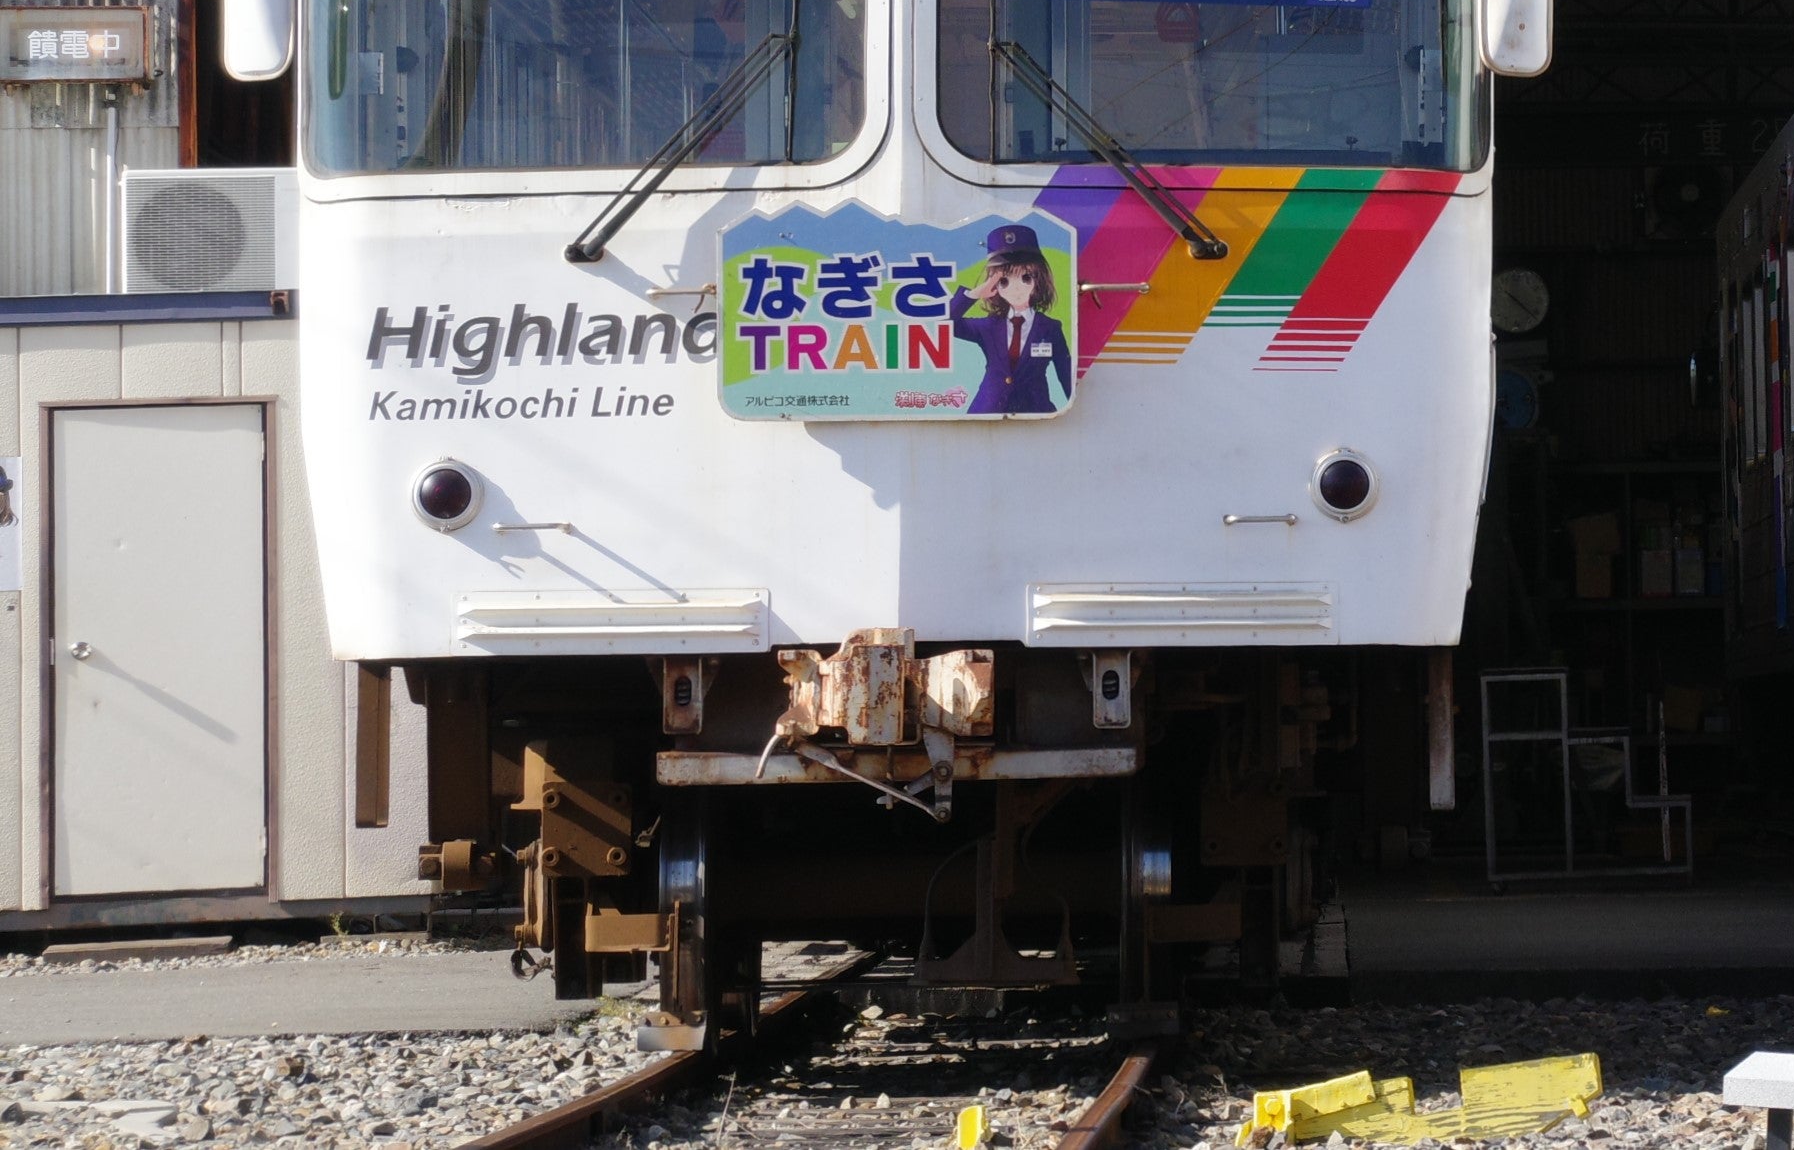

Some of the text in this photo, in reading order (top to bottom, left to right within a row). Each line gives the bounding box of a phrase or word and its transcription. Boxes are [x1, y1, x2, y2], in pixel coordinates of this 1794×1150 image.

[27, 29, 120, 59] 饋電中
[741, 254, 954, 320] なぎさ
[738, 323, 951, 370] TRAIN
[368, 386, 675, 421] Kamikochi Line
[744, 394, 850, 408] アルピコ交通株式会社
